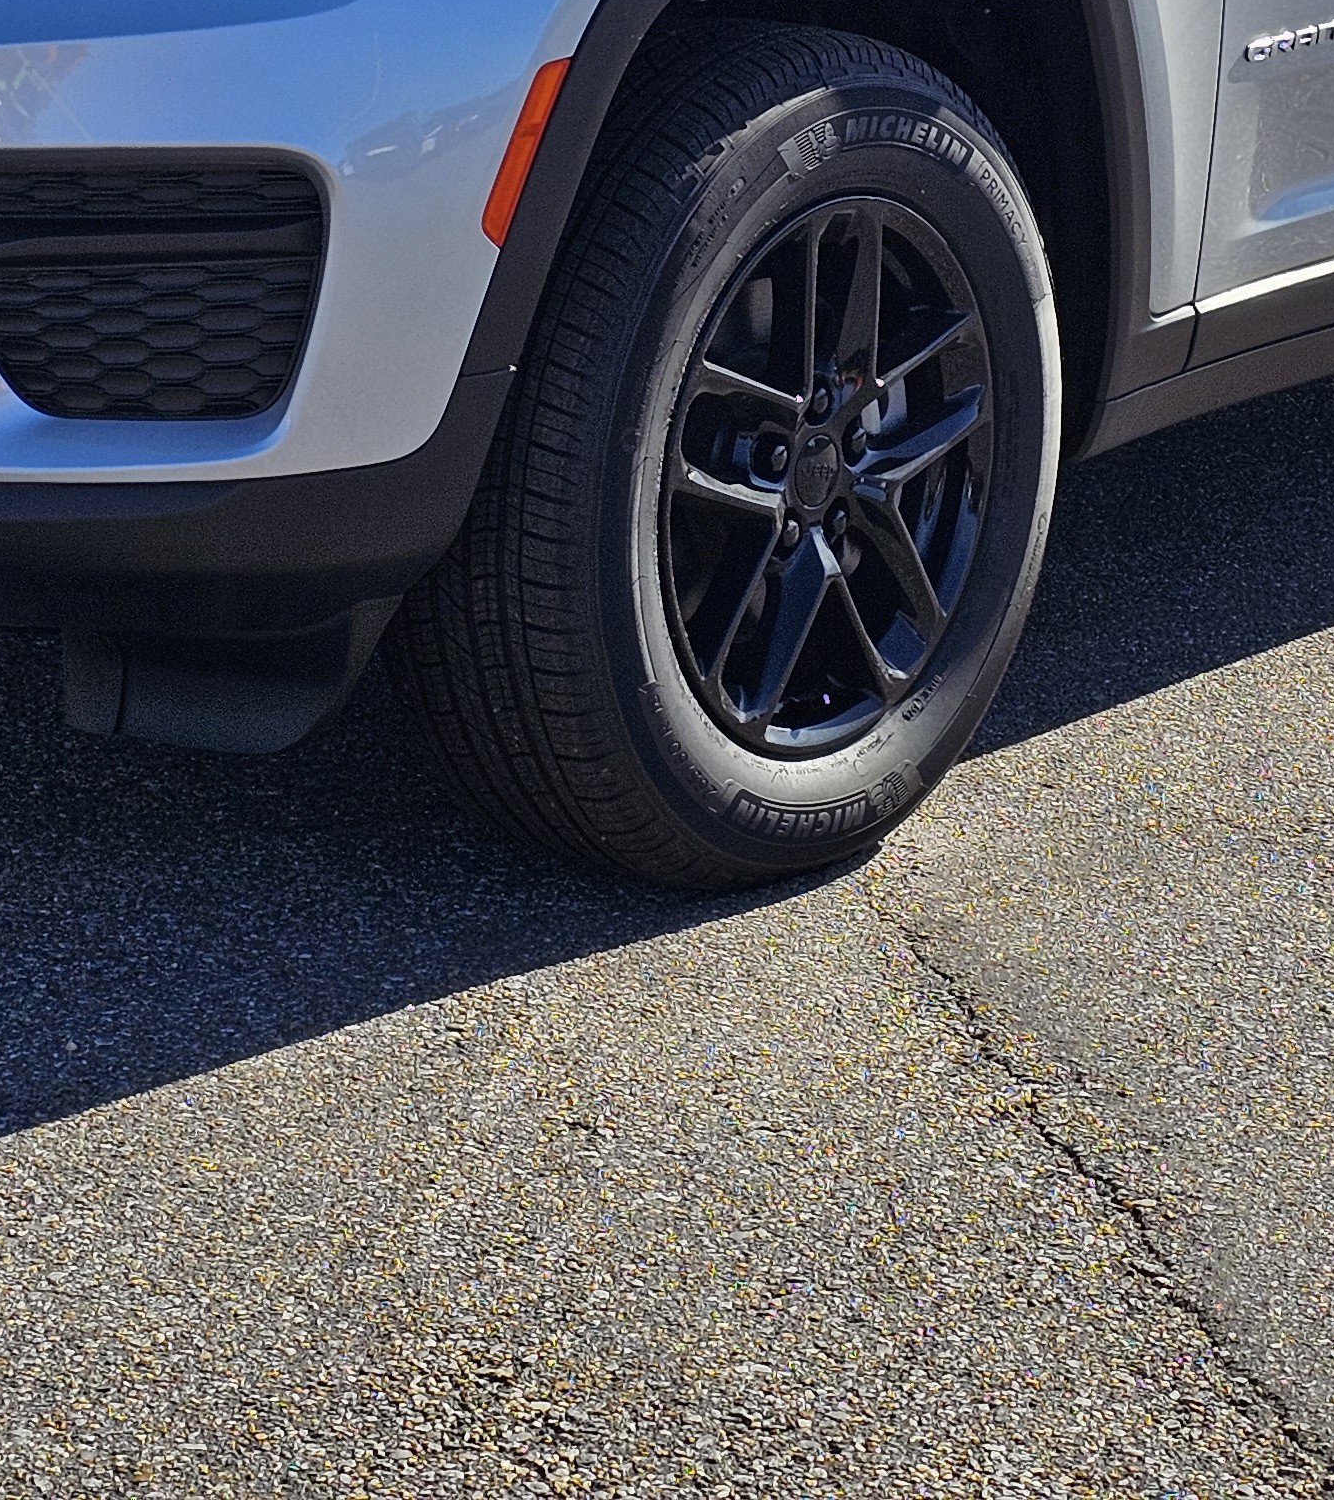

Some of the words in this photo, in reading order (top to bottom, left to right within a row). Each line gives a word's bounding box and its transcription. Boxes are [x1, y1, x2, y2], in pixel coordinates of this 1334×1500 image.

[845, 115, 967, 166] MICHELIN
[980, 168, 1029, 247] PRIMACY
[734, 799, 866, 837] MICHELIN
